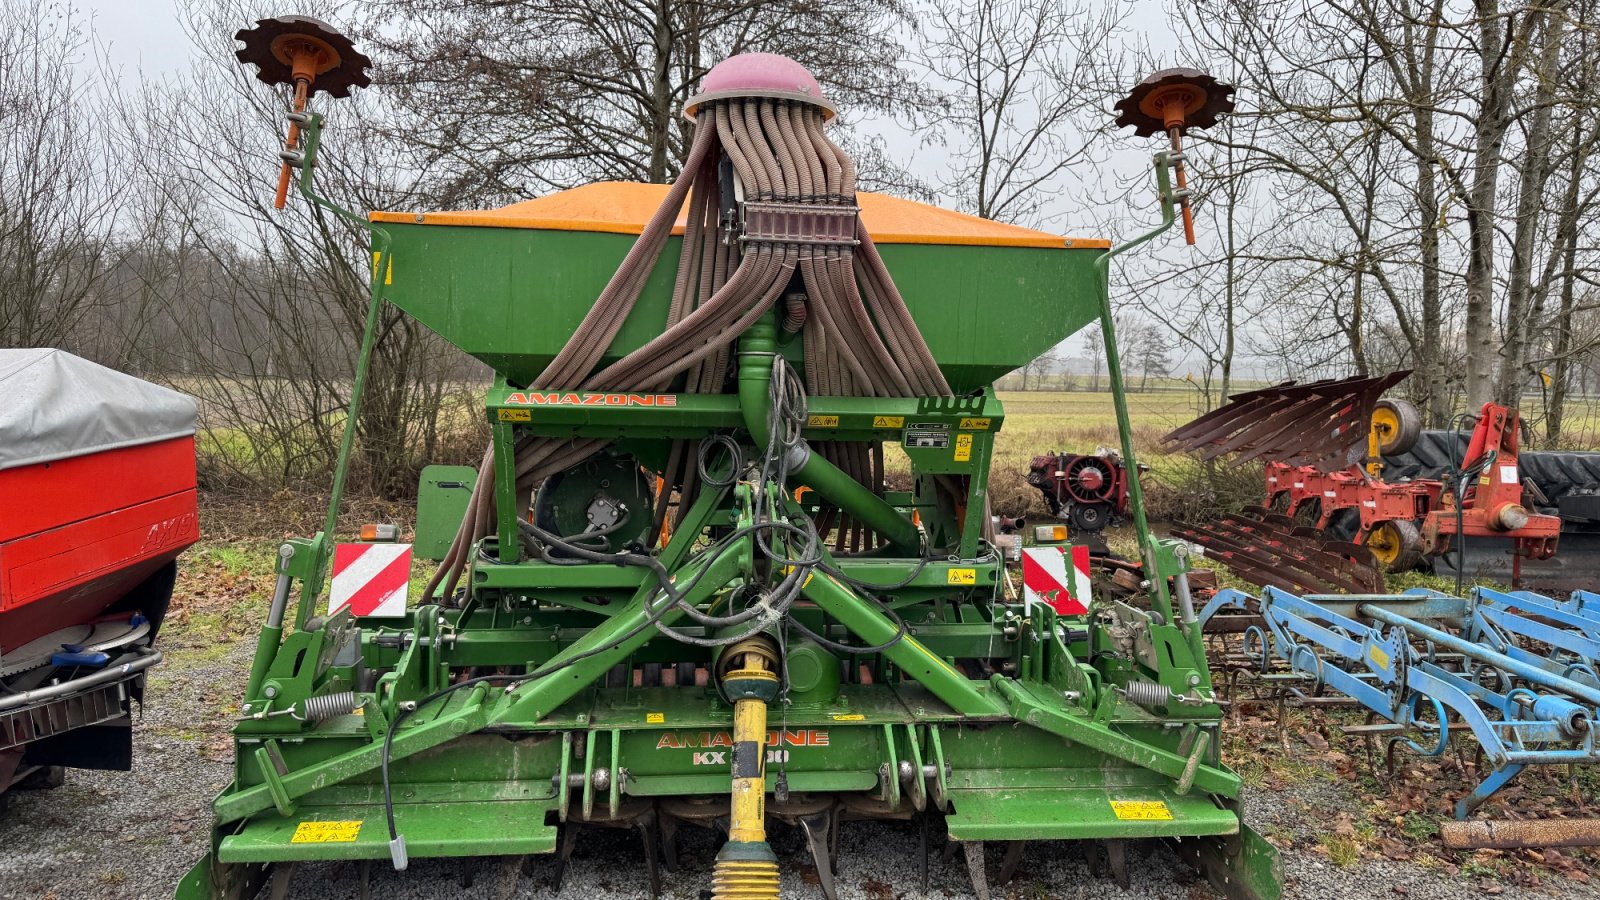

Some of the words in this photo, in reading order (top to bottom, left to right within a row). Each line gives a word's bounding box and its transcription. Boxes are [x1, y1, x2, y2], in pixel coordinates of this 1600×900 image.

[504, 392, 677, 406] AMAZONE
[141, 513, 195, 550] AXIS
[656, 730, 829, 749] AMAONE
[693, 751, 726, 765] KX
